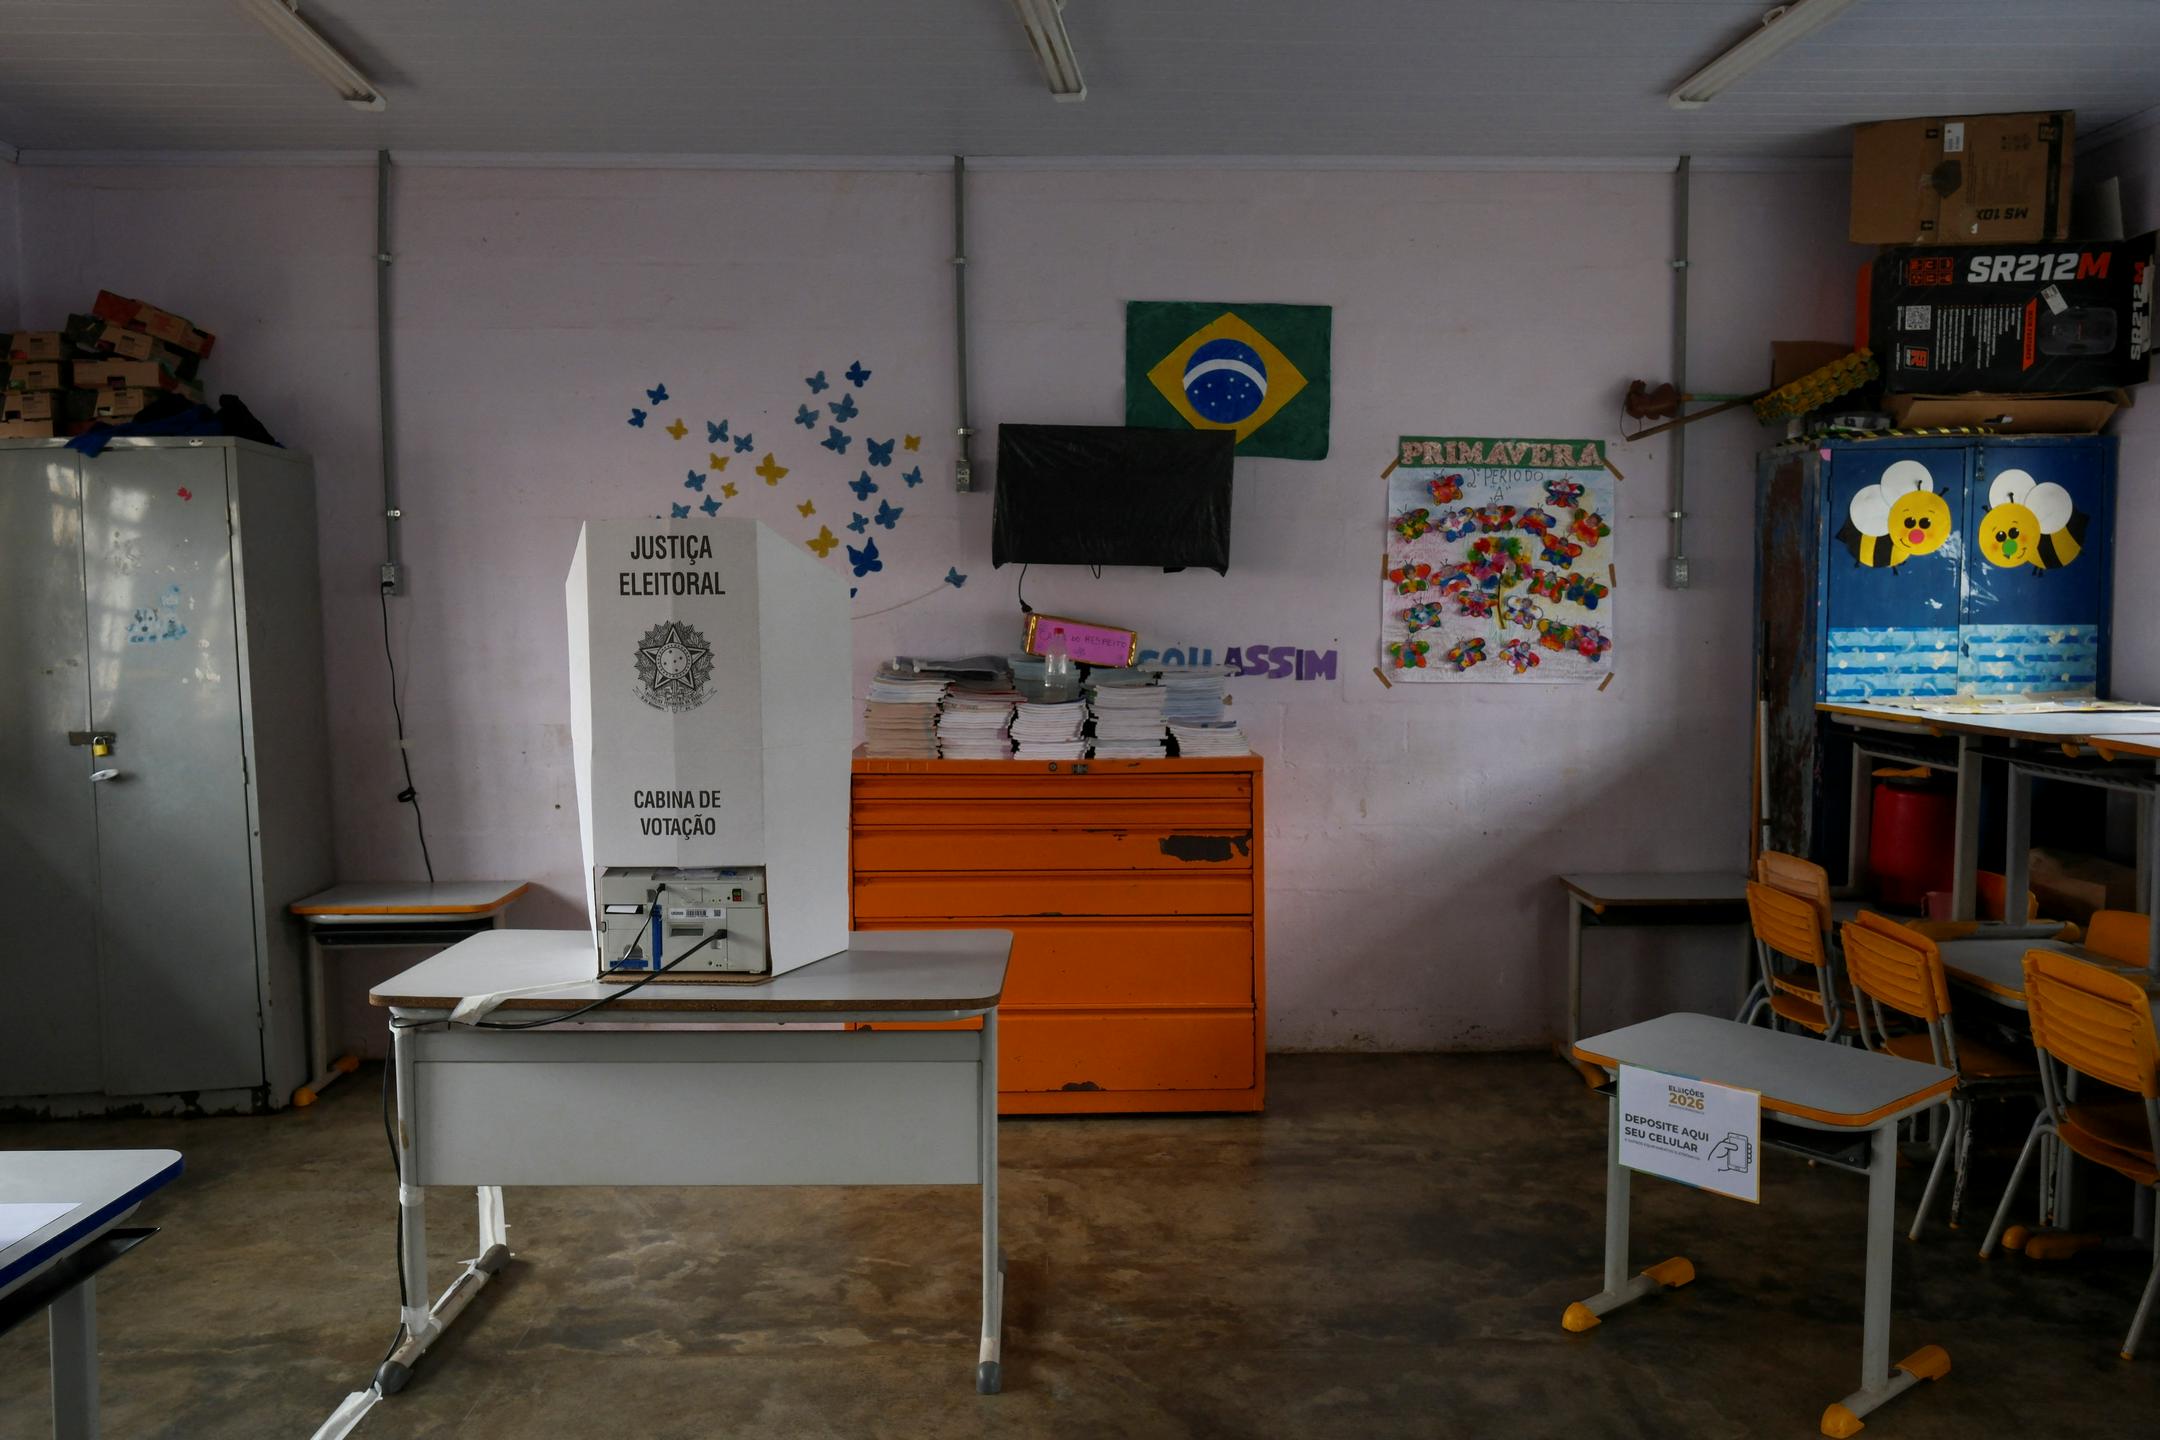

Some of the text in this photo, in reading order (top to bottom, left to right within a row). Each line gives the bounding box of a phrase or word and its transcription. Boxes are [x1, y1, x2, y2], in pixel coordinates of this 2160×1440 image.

[2004, 208, 2029, 220] MS
[1967, 252, 2112, 283] SR212M
[2130, 261, 2145, 361] SR212M
[1401, 440, 1604, 467] PRIMAVERA
[630, 535, 713, 565] JUSTIÇA
[619, 571, 726, 596] ELEITORAL
[1224, 645, 1338, 680] ASSIM
[634, 790, 721, 810] CABINA DE
[640, 813, 716, 840] VOTAÇÃO
[1669, 1092, 1705, 1110] 2026
[1625, 1112, 1709, 1142] DEPOSITE AQUI
[1625, 1126, 1646, 1139] SEU
[1648, 1132, 1698, 1153] CELULAR
